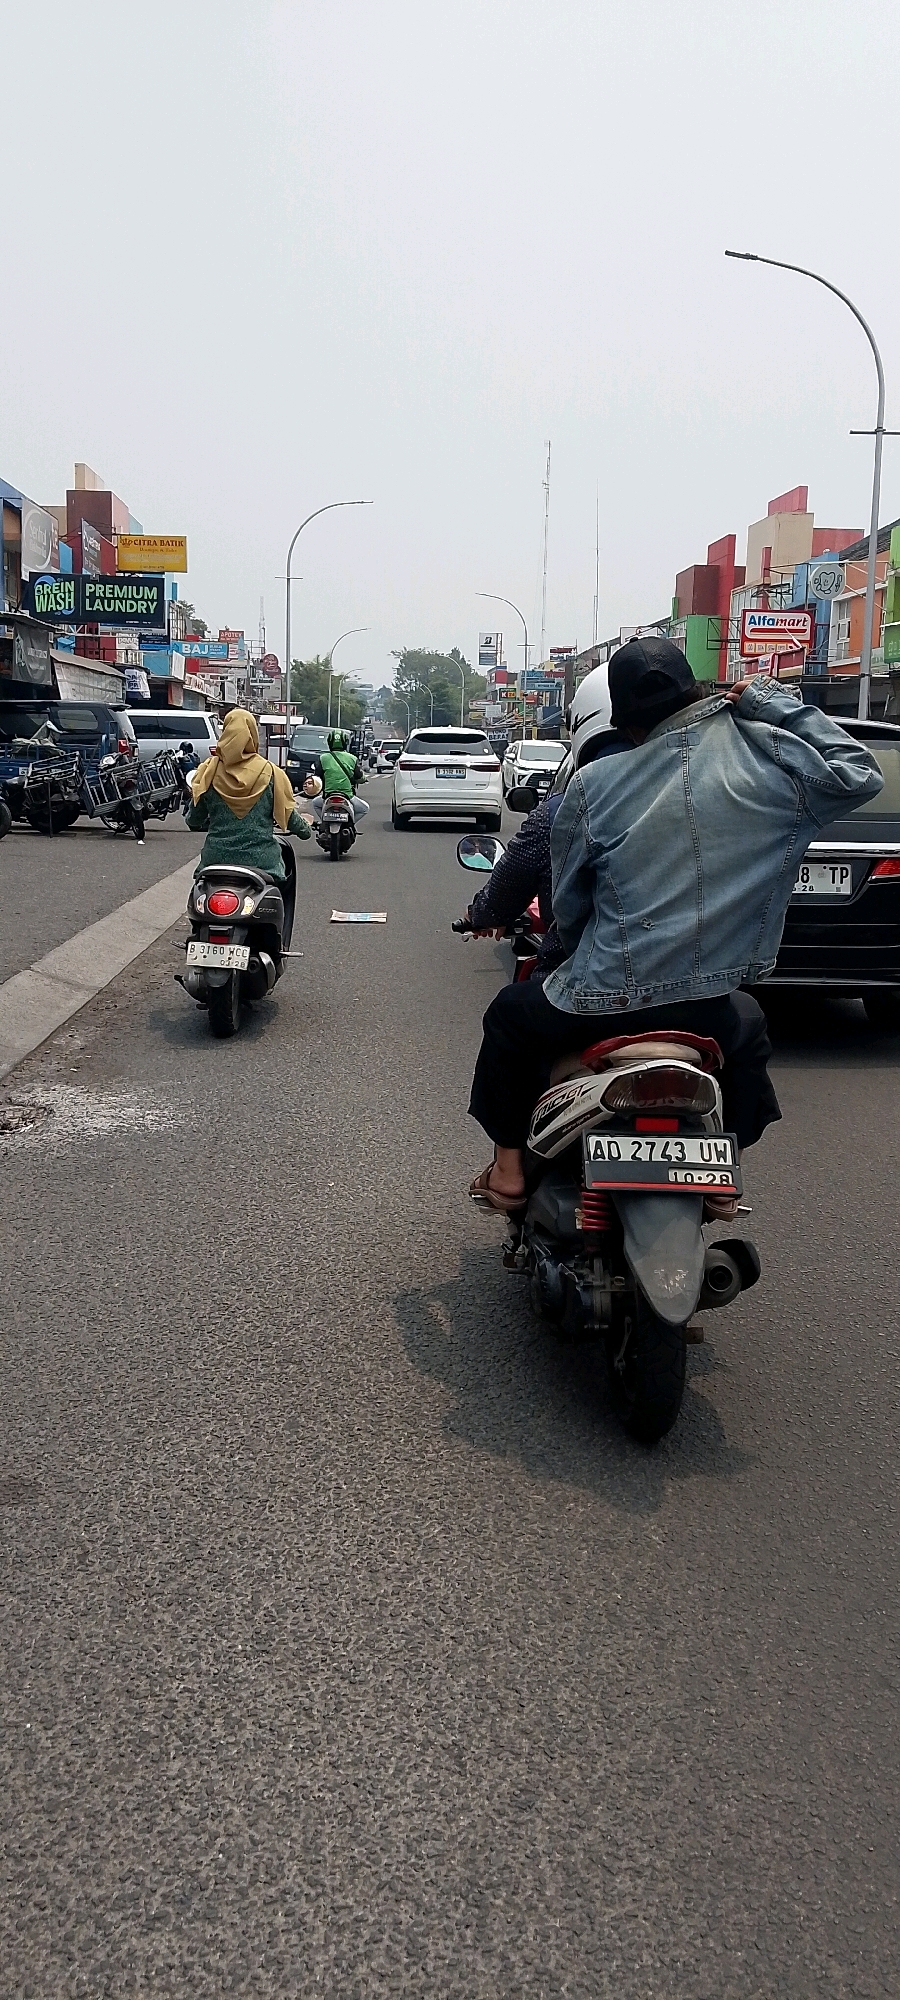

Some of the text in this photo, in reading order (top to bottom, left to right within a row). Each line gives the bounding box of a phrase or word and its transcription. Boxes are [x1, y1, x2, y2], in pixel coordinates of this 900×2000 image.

[133, 539, 184, 547] CITRA BATIK
[35, 581, 75, 596] BREIN
[86, 583, 158, 600] PREMIUM
[36, 592, 75, 612] WASH
[86, 598, 158, 614] LAUNDRY
[748, 615, 808, 627] Alfamart
[182, 644, 209, 655] BAJ
[829, 866, 849, 885] TP
[190, 944, 248, 958] B 3160 WCC
[592, 1140, 727, 1163] AD 2743 UW
